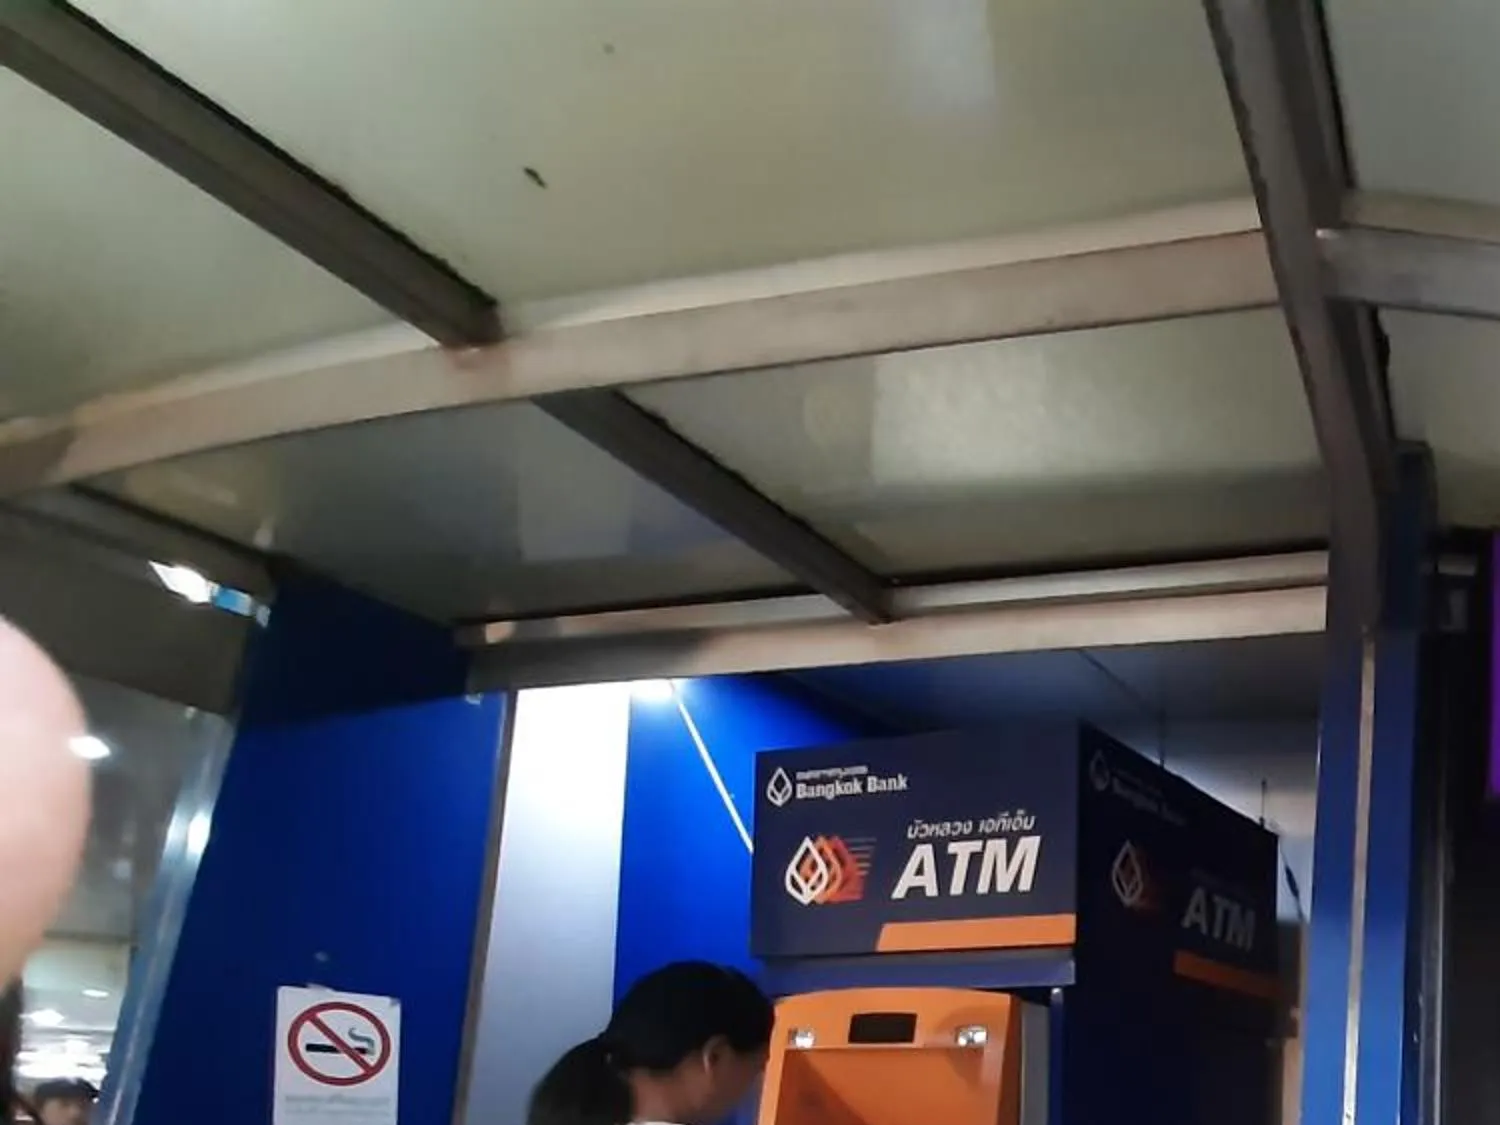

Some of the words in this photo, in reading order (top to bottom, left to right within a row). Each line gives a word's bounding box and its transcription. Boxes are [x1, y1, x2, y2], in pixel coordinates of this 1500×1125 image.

[795, 777, 864, 800] Bangkok
[867, 773, 908, 792] Bank
[891, 835, 1041, 900] ATM
[1180, 886, 1256, 952] ATM
